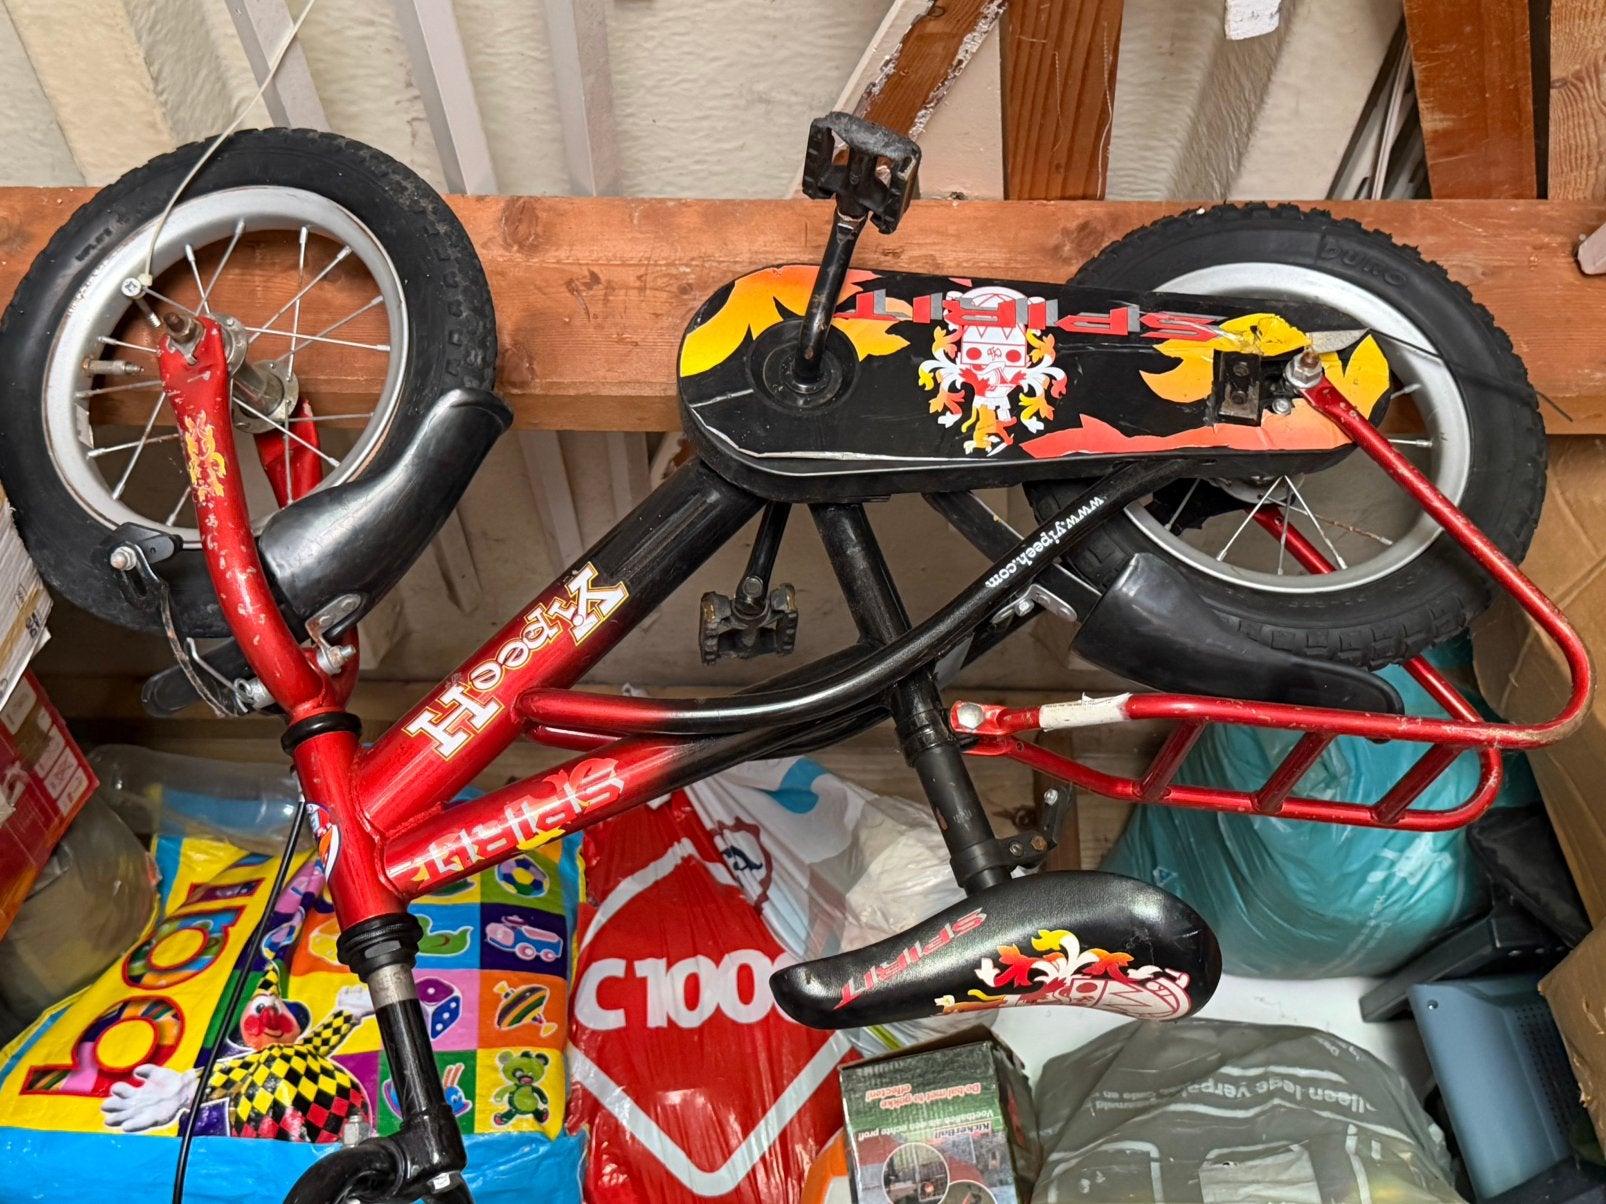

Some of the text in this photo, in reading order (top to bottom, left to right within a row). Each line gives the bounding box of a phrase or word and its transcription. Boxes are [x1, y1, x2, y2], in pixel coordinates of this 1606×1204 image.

[1320, 241, 1408, 288] DURO
[832, 287, 1228, 342] SPIRIT
[984, 496, 1105, 588] www.yipeeh.com
[410, 764, 625, 889] SPIRIT
[833, 906, 988, 1011] SPIRIT
